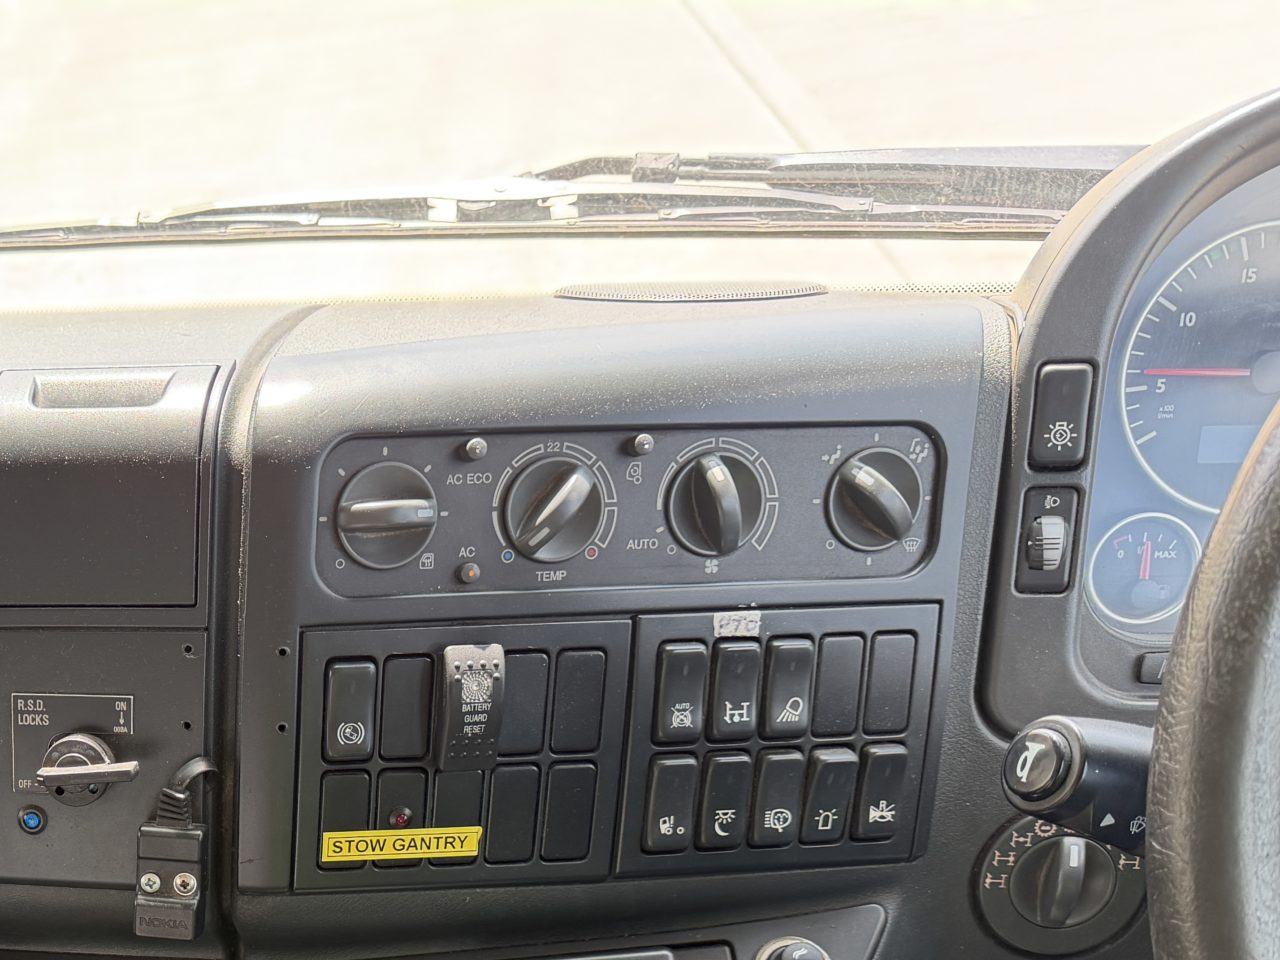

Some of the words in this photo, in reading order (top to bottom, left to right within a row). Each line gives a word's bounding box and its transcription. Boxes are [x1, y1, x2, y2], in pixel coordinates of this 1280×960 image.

[1242, 268, 1257, 283] 15
[1179, 312, 1196, 327] 10
[1155, 378, 1166, 393] 5
[547, 442, 560, 451] 22
[446, 474, 463, 485] AC
[467, 473, 492, 484] ECO
[627, 538, 659, 550] AUTO
[459, 546, 476, 558] AC
[1154, 550, 1177, 559] MAX
[536, 570, 567, 581] TEMP
[17, 699, 46, 711] R.S.D.
[115, 701, 127, 711] ON
[462, 703, 492, 713] BATTERY
[675, 702, 690, 710] AUTO
[18, 714, 49, 726] LOCKS
[464, 713, 488, 723] GUARD
[463, 724, 486, 734] RESET
[18, 780, 32, 789] OFF
[332, 838, 387, 854] STOW
[392, 835, 469, 851] GANTRY
[139, 917, 188, 930] NOKIA
